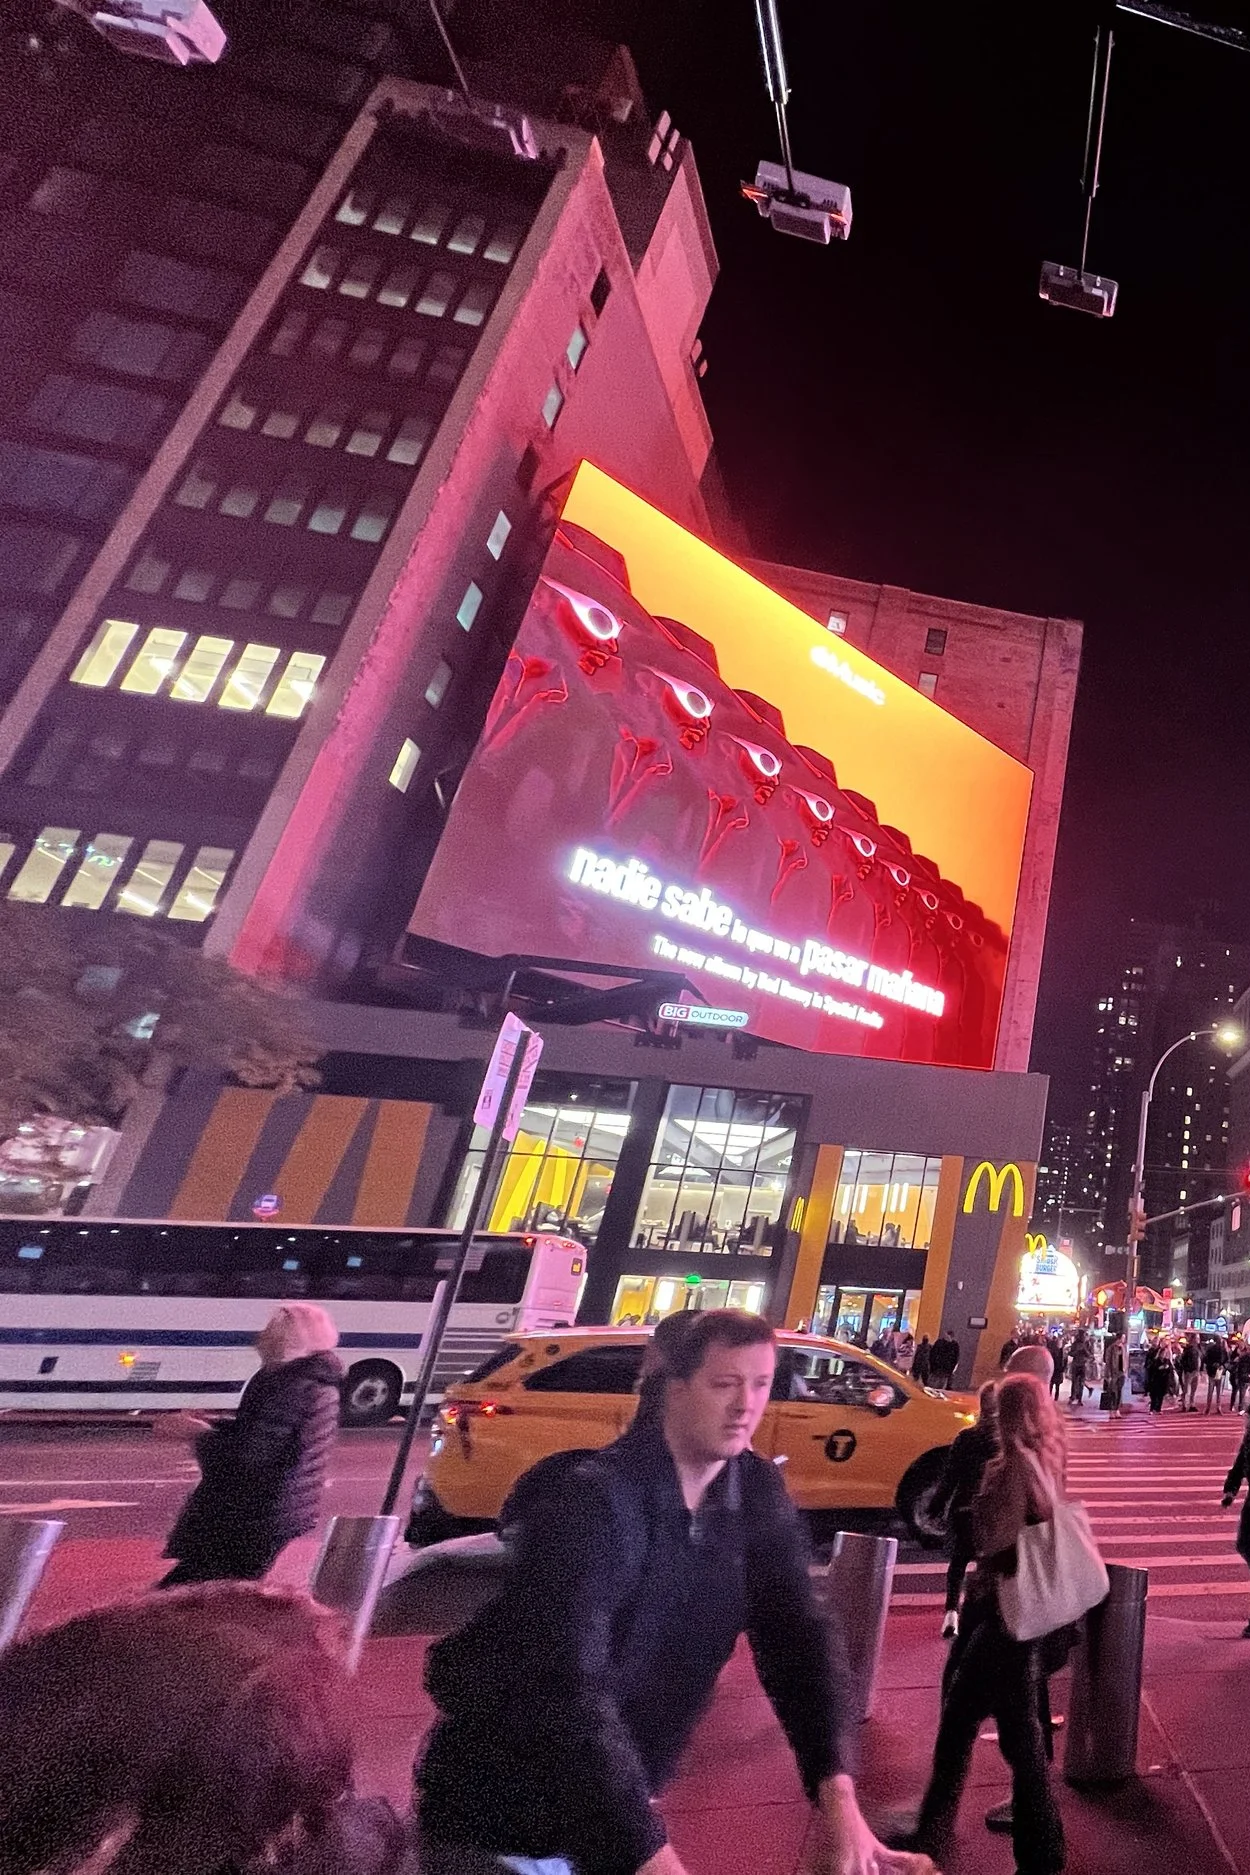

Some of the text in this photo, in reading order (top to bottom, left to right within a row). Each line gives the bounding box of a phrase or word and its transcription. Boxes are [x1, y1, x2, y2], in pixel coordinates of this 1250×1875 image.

[569, 847, 662, 911] nadie
[661, 885, 733, 936] sabe
[800, 939, 870, 987] pasar
[664, 1005, 743, 1023] BIG OUTDOOR
